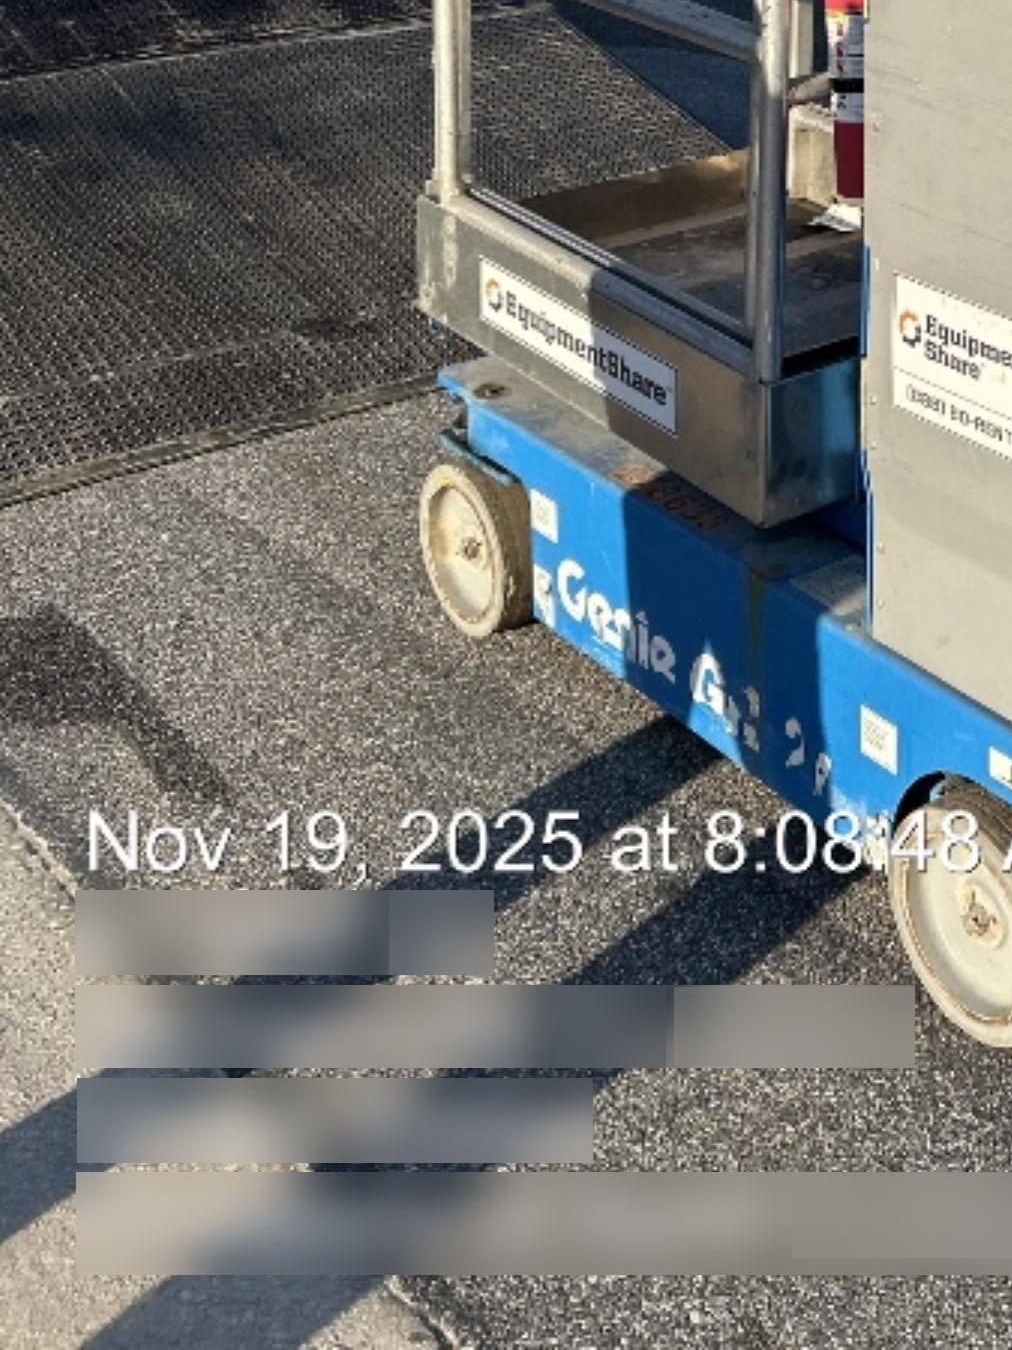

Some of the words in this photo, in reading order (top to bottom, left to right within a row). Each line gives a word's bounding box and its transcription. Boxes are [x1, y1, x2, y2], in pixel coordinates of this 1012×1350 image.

[505, 290, 668, 406] EquipmentShare
[924, 338, 981, 381] Share
[557, 559, 677, 686] Genie
